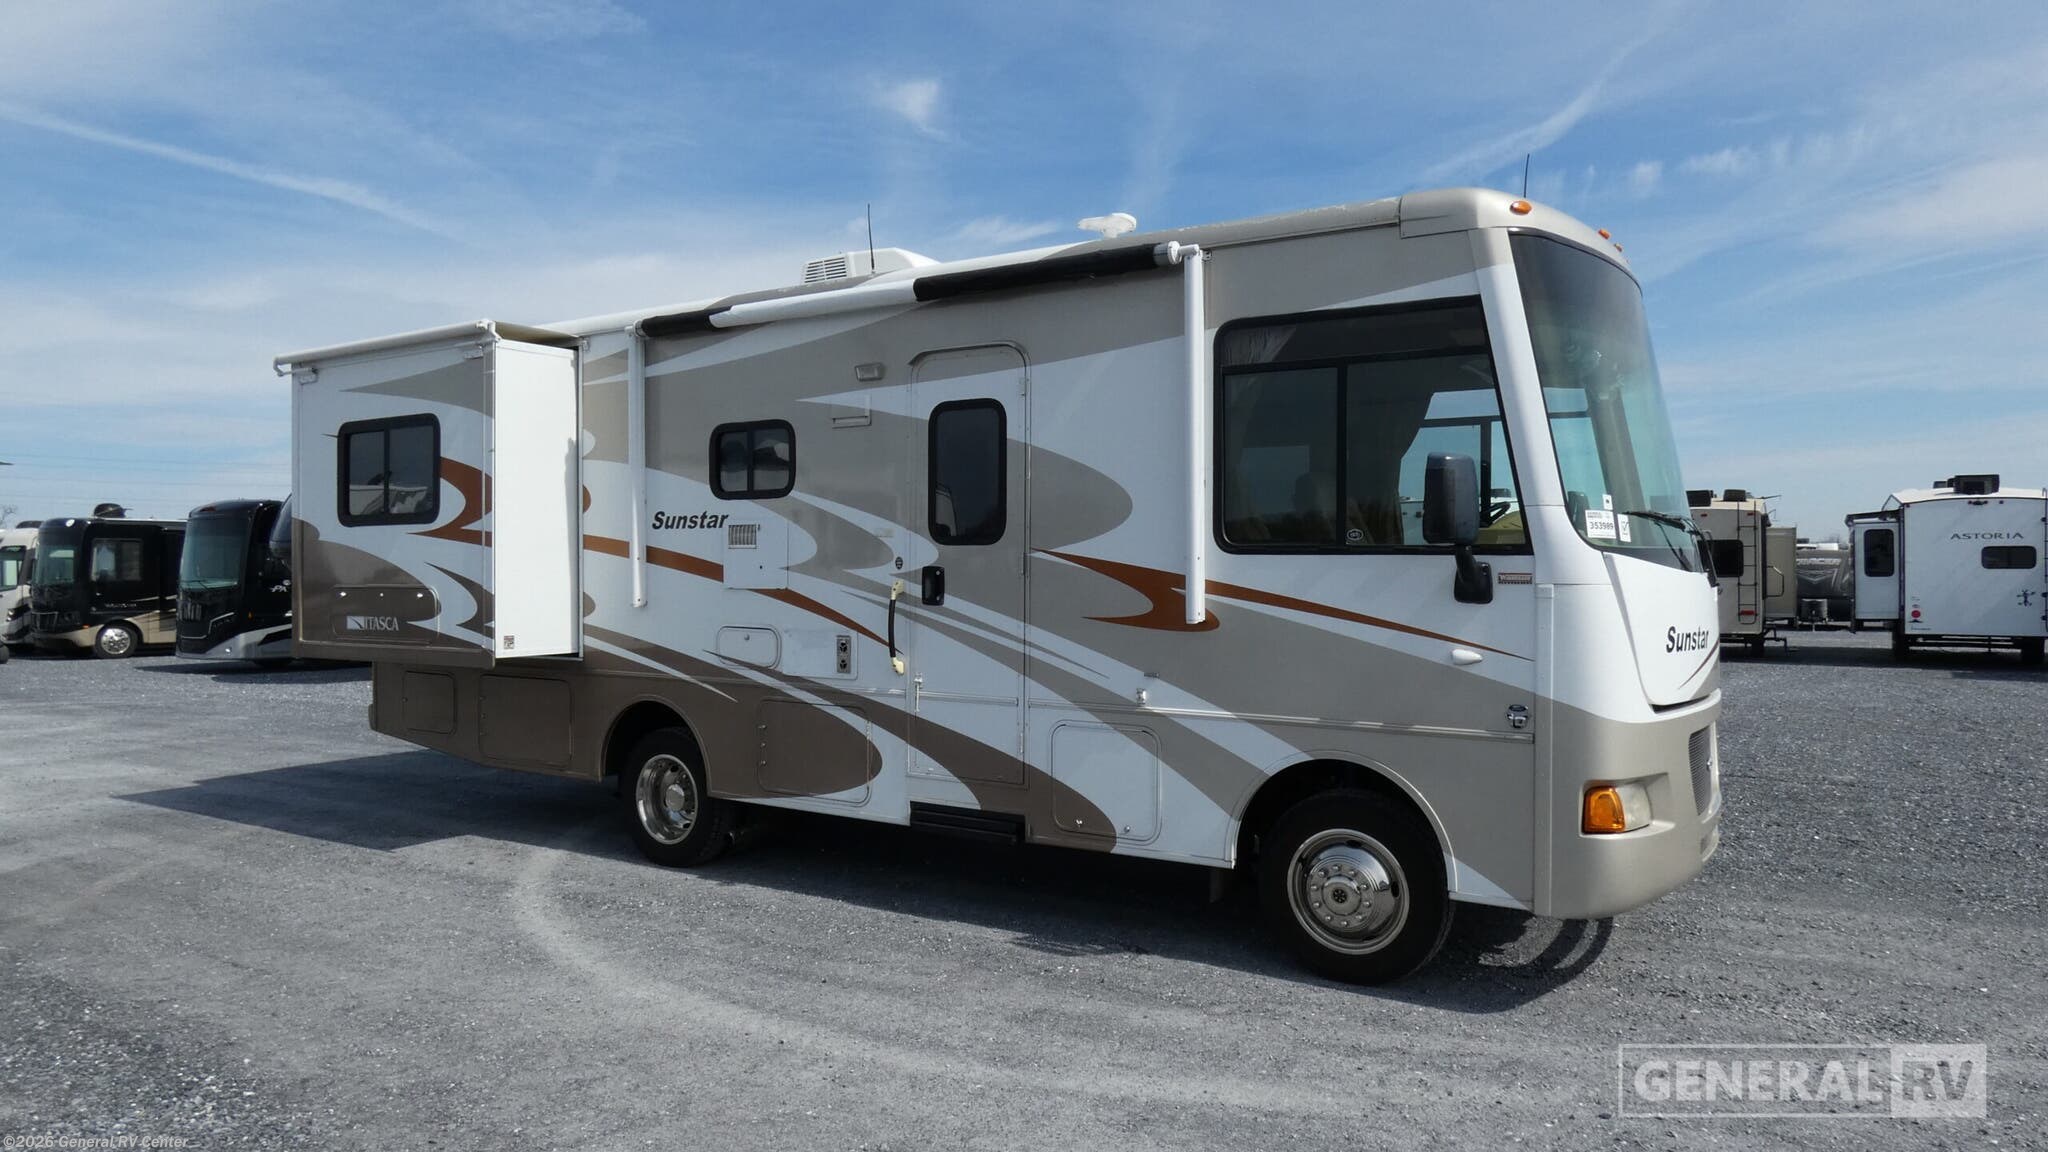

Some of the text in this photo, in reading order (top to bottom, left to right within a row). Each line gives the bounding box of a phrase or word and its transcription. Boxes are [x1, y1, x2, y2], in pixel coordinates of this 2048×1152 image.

[651, 510, 729, 530] Sunstar
[1950, 532, 2024, 540] ASTORIA
[364, 616, 400, 631] ITASCA
[1665, 625, 1709, 653] Sunstar
